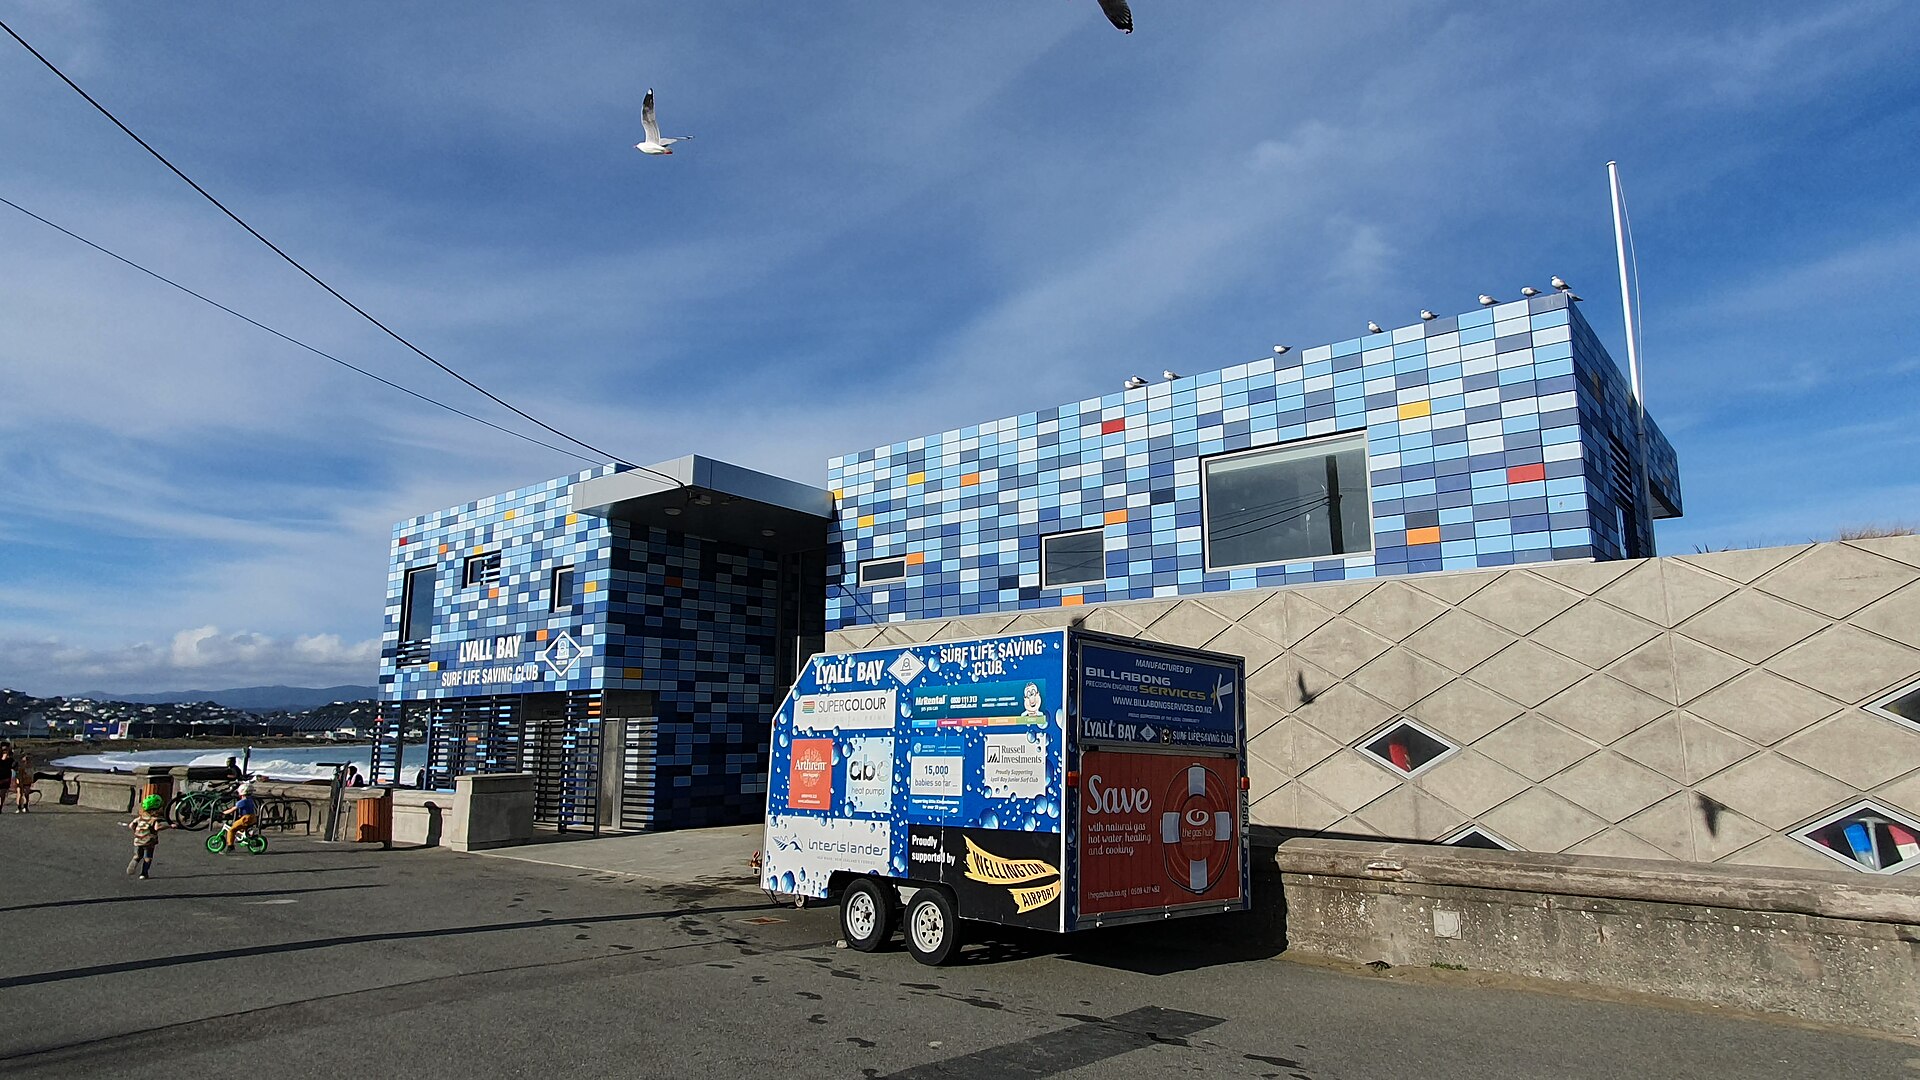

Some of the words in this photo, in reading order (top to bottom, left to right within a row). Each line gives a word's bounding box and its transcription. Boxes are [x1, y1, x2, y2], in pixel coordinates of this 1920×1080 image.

[459, 639, 494, 663] LYALL
[496, 634, 521, 659] BAY
[940, 647, 968, 664] SURF
[970, 644, 994, 661] LIFE
[998, 639, 1042, 659] SAVING
[816, 662, 853, 685] LYALL
[857, 660, 884, 682] BAY
[974, 660, 1002, 677] CLUB
[1135, 659, 1184, 673] MANUFACTURED
[1185, 667, 1194, 675] BY
[441, 671, 462, 687] SURF
[463, 668, 481, 685] LIFE
[482, 666, 513, 684] SAVING
[515, 664, 538, 681] CLUB
[1085, 666, 1171, 686] BILLABONG
[1085, 680, 1111, 689] PRECISION
[1112, 683, 1139, 692] ENGINEERS
[1139, 685, 1206, 701] SERVICES
[818, 697, 887, 713] SUPERCOLOUR
[916, 696, 945, 706] MrRental
[1112, 696, 1213, 714] WWW.BILLABONGSERVICES.CO.NZ
[1083, 720, 1115, 739] LYALL
[1118, 724, 1137, 740] BAY
[1173, 730, 1187, 739] SURF
[1200, 733, 1220, 742] SAVING
[1002, 745, 1025, 754] Russell
[795, 759, 825, 771] Arthrem
[1001, 754, 1042, 764] Investments
[849, 754, 891, 782] abc
[925, 765, 949, 776] 15,000
[914, 778, 933, 787] babies
[934, 779, 941, 787] so
[851, 786, 864, 796] heat
[865, 787, 885, 797] pumps
[1087, 774, 1152, 814] Save
[1088, 822, 1105, 832] with
[1106, 821, 1132, 832] natural
[1134, 824, 1146, 835] gas
[1202, 827, 1214, 838] hub
[912, 835, 938, 850] Proudly
[1089, 833, 1100, 844] hot
[1125, 832, 1151, 845] heating
[808, 838, 888, 856] interislander
[1089, 845, 1104, 856] and
[1106, 844, 1134, 857] cooking
[911, 851, 945, 866] supported
[946, 853, 956, 867] by
[973, 850, 1047, 878] WELLINGTON
[1020, 886, 1055, 908] AIRPORT
